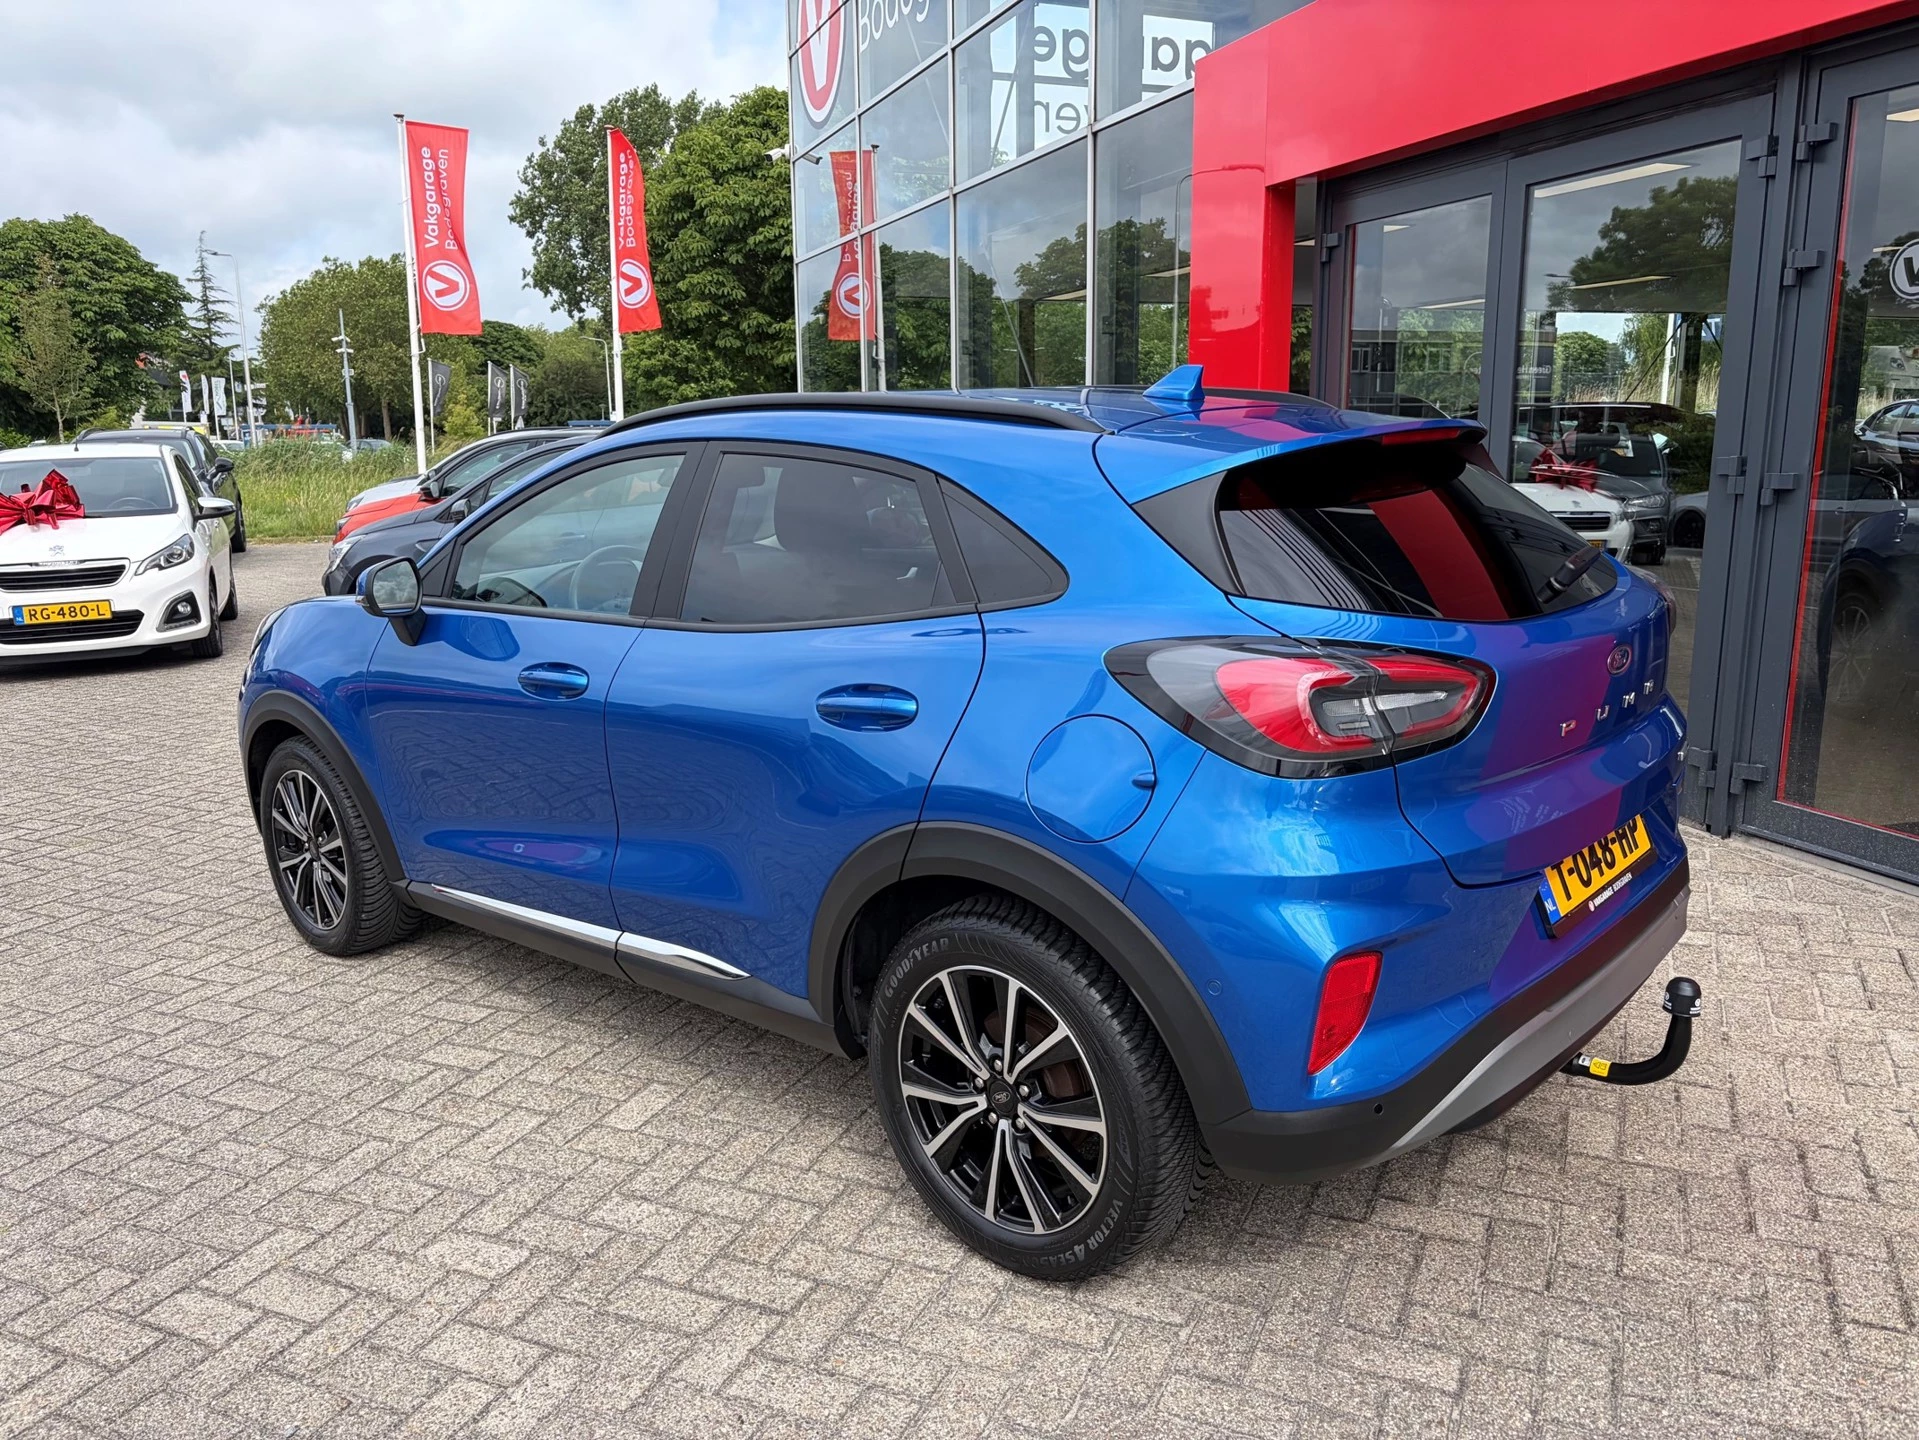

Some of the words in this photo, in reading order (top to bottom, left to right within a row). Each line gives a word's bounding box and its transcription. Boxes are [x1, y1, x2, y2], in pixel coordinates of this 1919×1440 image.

[421, 146, 442, 249] Vakgarage
[438, 149, 459, 250] Bodegraven
[626, 149, 637, 248] Bodegraven
[28, 604, 106, 621] RG-480-L
[1551, 817, 1640, 902] T-048-HP
[1544, 898, 1557, 914] NL
[884, 937, 949, 998] GOODYEAR
[1087, 1199, 1124, 1251] VECTOR
